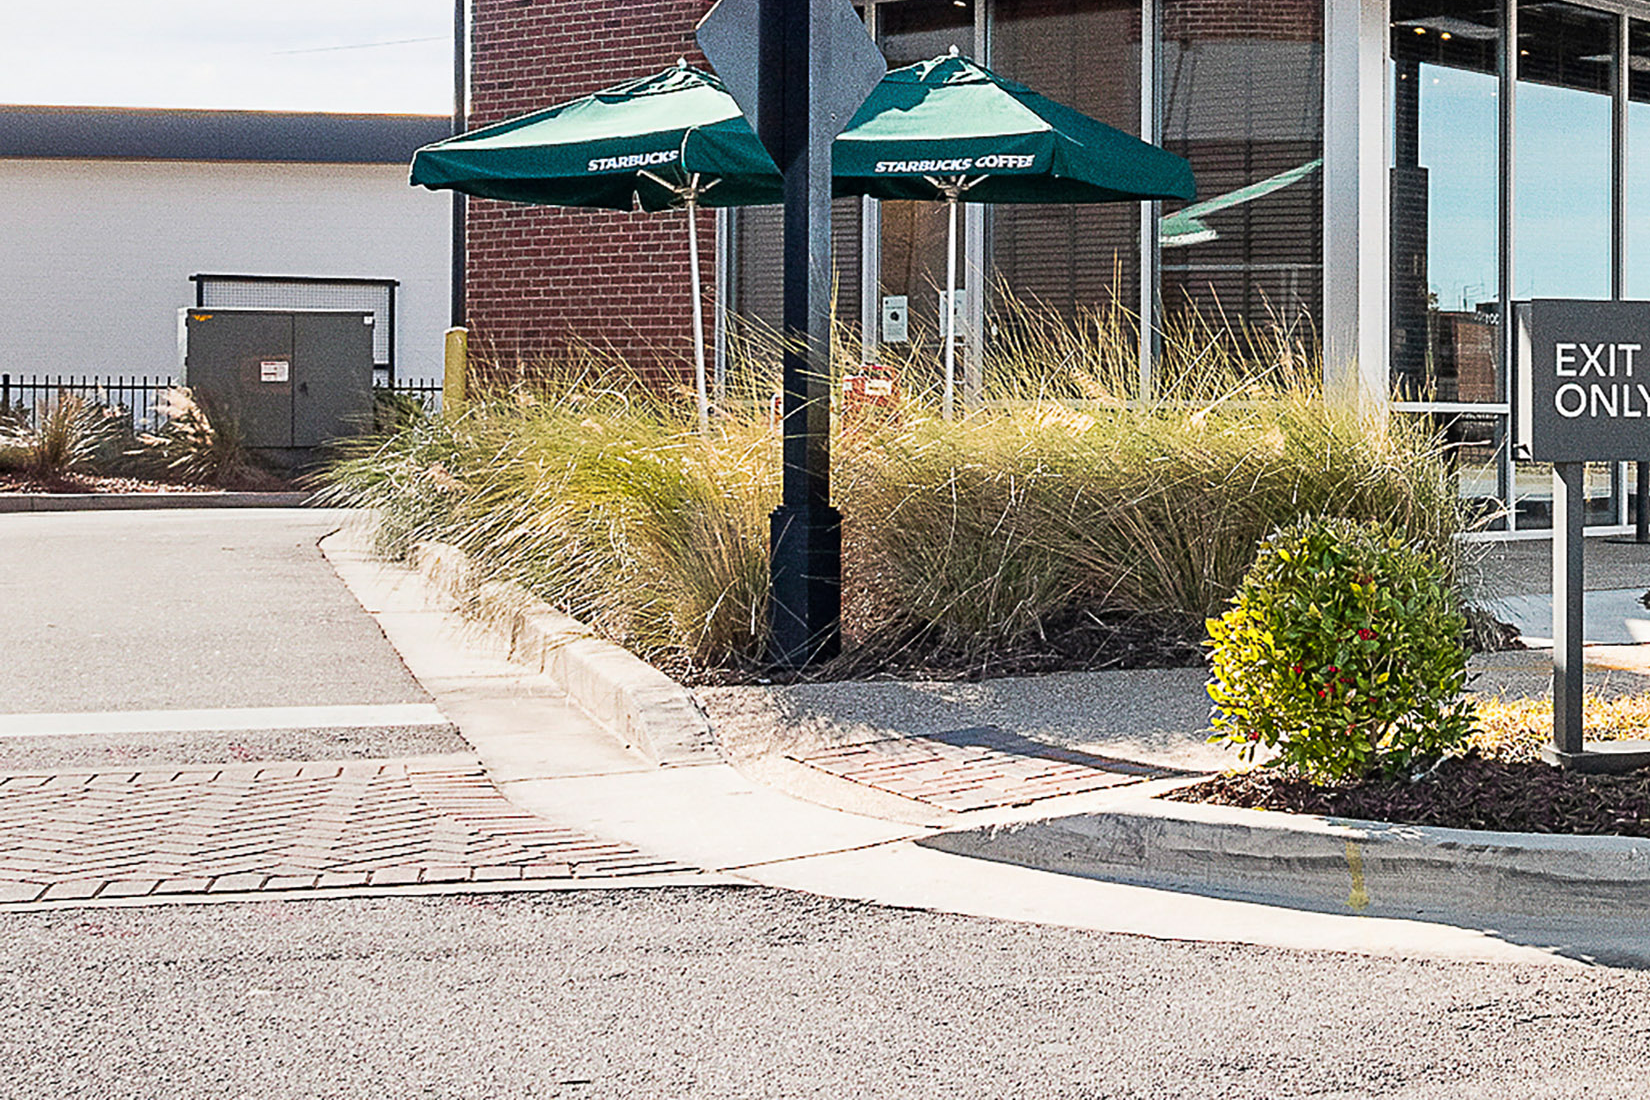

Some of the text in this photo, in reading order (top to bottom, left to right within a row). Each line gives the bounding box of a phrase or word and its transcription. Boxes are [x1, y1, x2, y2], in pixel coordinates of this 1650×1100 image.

[587, 150, 680, 172] STARBUCKS
[874, 154, 1036, 174] STARBUCKS COFFEE
[1555, 343, 1642, 377] EXIT
